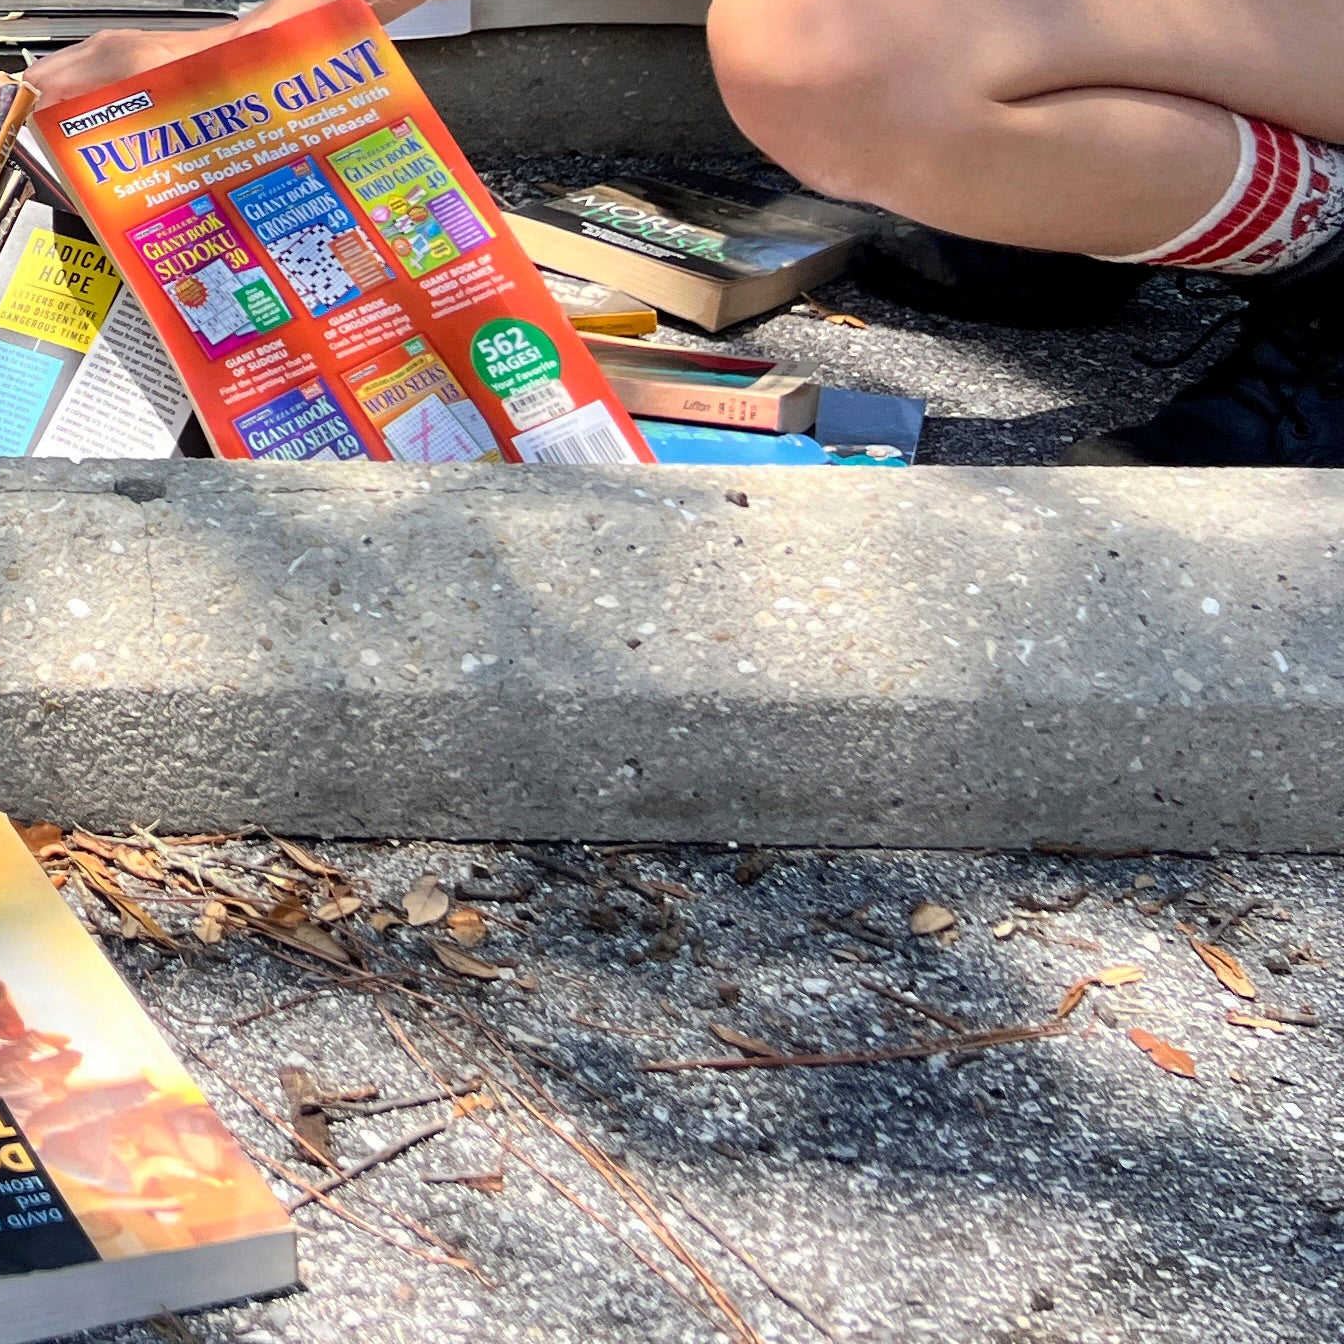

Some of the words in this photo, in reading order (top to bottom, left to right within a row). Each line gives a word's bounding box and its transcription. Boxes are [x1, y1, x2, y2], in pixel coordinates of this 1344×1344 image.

[63, 91, 152, 137] PennyPress
[77, 94, 270, 185] PUZZLER'S
[272, 38, 387, 113] GIANT
[114, 165, 172, 199] Satisfy
[172, 152, 212, 175] Your
[212, 137, 249, 161] Taste
[257, 126, 287, 145] For
[287, 103, 348, 133] Puzzles
[348, 85, 391, 111] With
[144, 177, 200, 209] Jumbo
[201, 159, 254, 187] Books
[253, 142, 300, 169] Made
[298, 131, 322, 150] To
[322, 109, 381, 140] Please!
[256, 191, 339, 242] CROSSWORDS
[32, 238, 120, 279] RADICAL
[142, 229, 187, 262] GIANT
[154, 229, 238, 283] SUDOKU
[38, 264, 95, 296] HOPE
[12, 288, 56, 309] LETTERS
[56, 300, 70, 312] OF
[71, 304, 98, 322] LOVE
[33, 305, 77, 327] DISSENT
[77, 318, 90, 332] IN
[0, 308, 59, 335] DANGEROUS
[60, 327, 91, 347] TIMES
[476, 327, 533, 362] 562
[486, 348, 544, 379] PAGES!
[514, 359, 558, 385] Favorite
[683, 399, 711, 413] Lifton
[6, 1206, 65, 1228] DAVID
[15, 1190, 53, 1211] and
